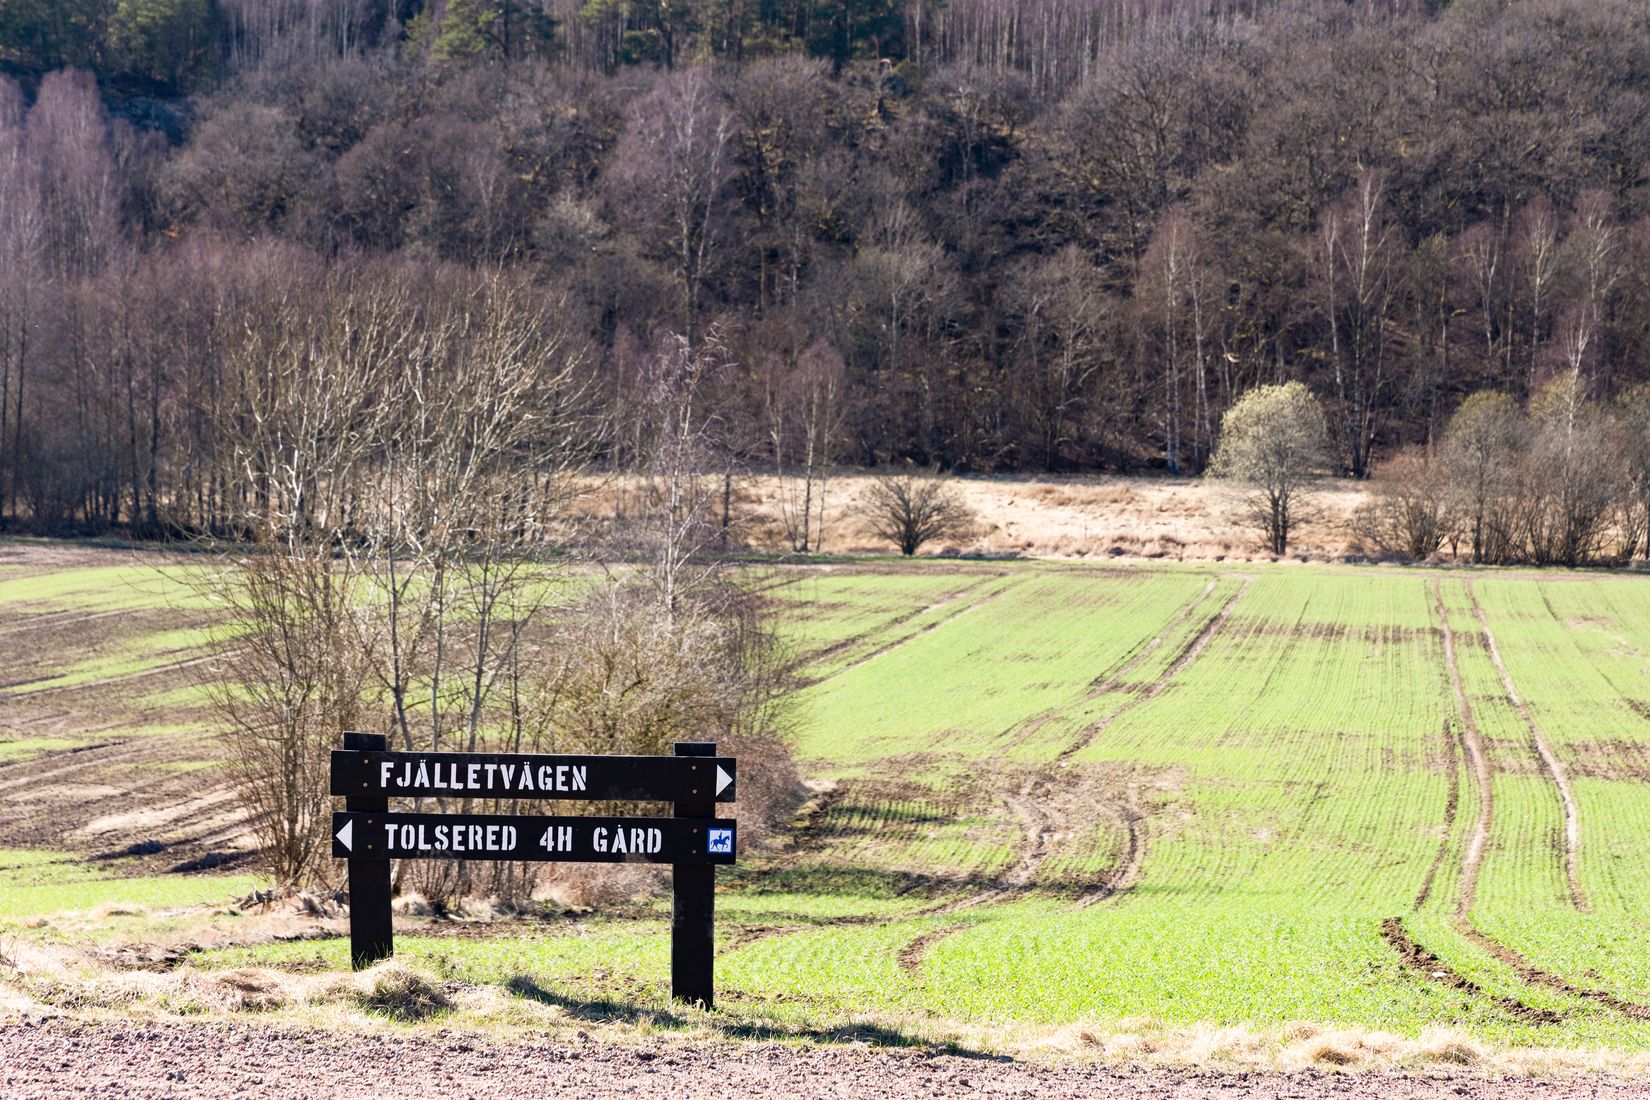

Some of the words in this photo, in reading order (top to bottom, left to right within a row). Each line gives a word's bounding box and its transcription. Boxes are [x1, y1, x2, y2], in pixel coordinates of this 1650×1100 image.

[380, 759, 587, 792] FJÄLLETVÄGEN
[384, 823, 517, 851] TOLSERED
[539, 826, 573, 852] 4H
[593, 823, 662, 854] GÅRD
